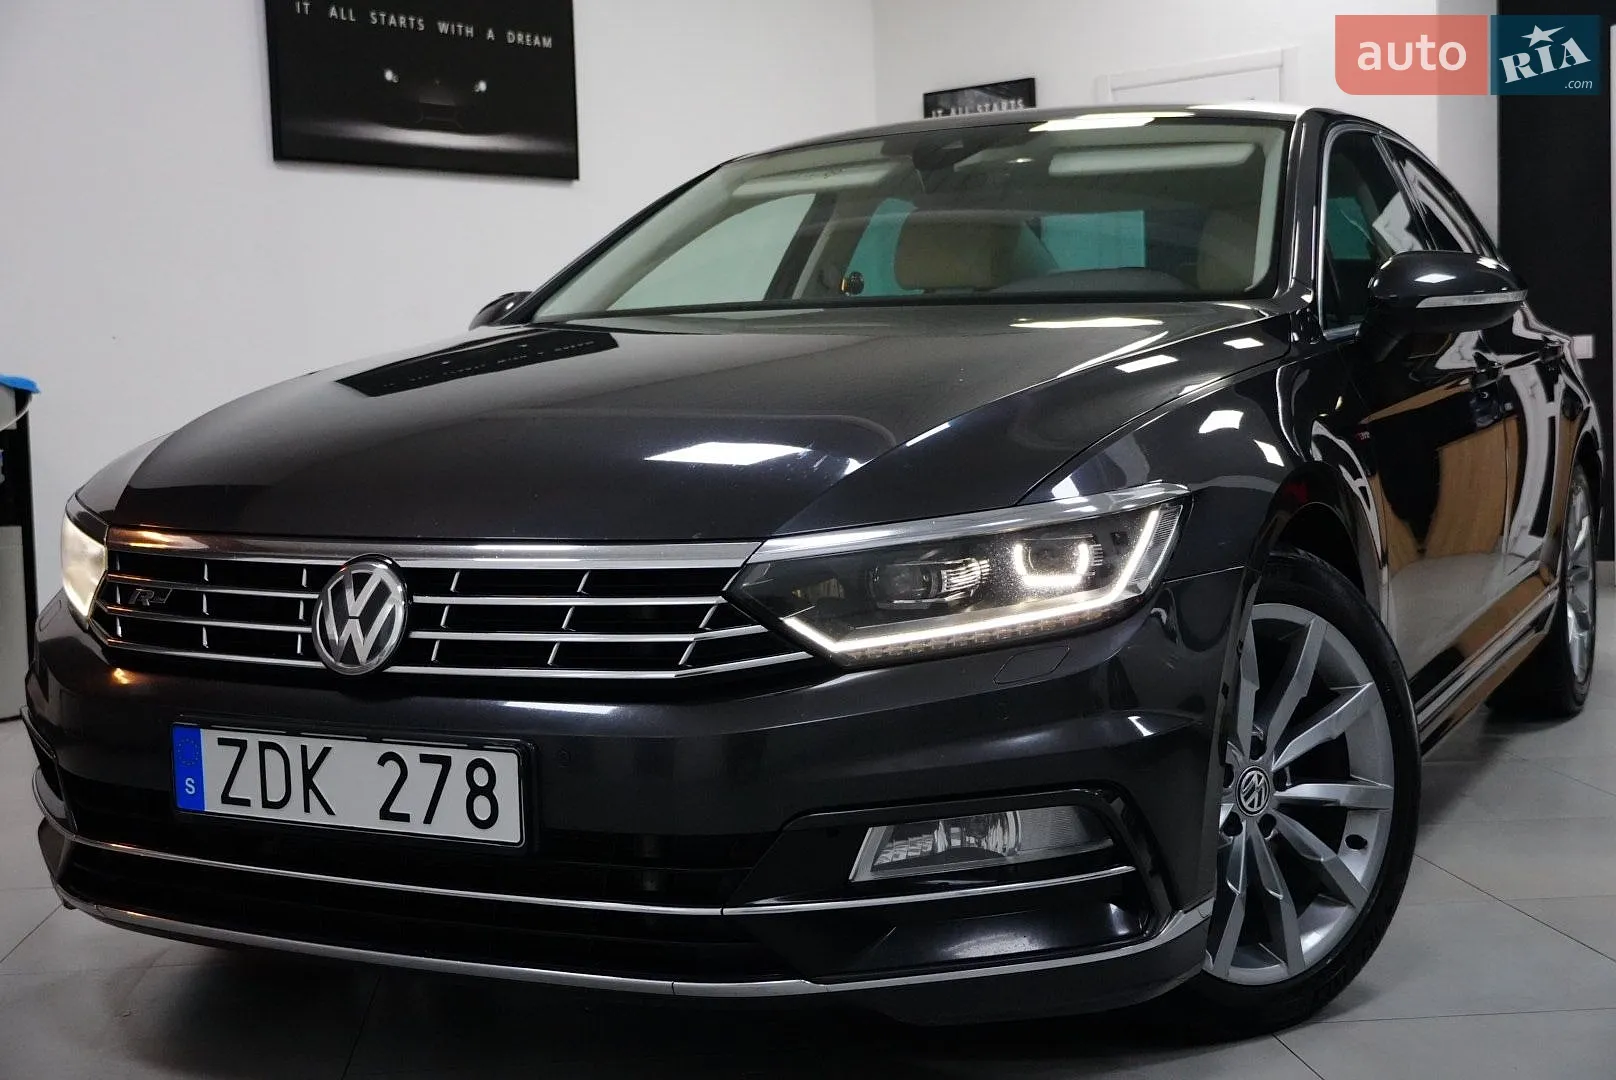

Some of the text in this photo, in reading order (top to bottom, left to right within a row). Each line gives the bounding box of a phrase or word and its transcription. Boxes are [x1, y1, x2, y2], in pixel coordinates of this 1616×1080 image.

[295, 1, 553, 49] IT ALL STARTS WITH A DREAM
[184, 777, 197, 795] S
[217, 737, 500, 829] ZDK 278
